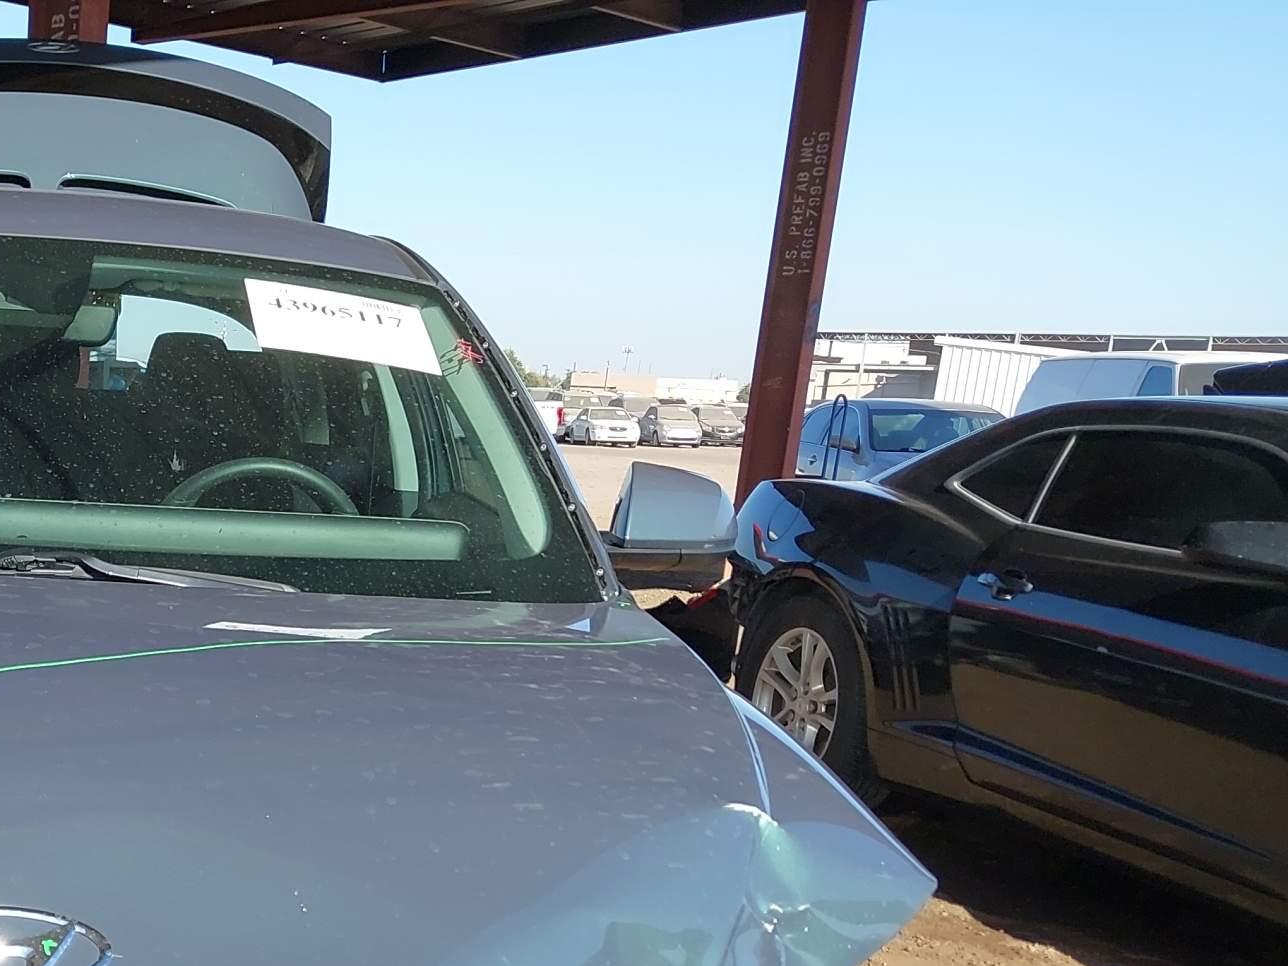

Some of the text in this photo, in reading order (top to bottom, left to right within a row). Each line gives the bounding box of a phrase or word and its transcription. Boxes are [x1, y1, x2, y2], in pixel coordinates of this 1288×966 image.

[789, 171, 810, 236] PREFAB
[800, 130, 817, 164] INC.
[268, 297, 402, 328] 43965117
